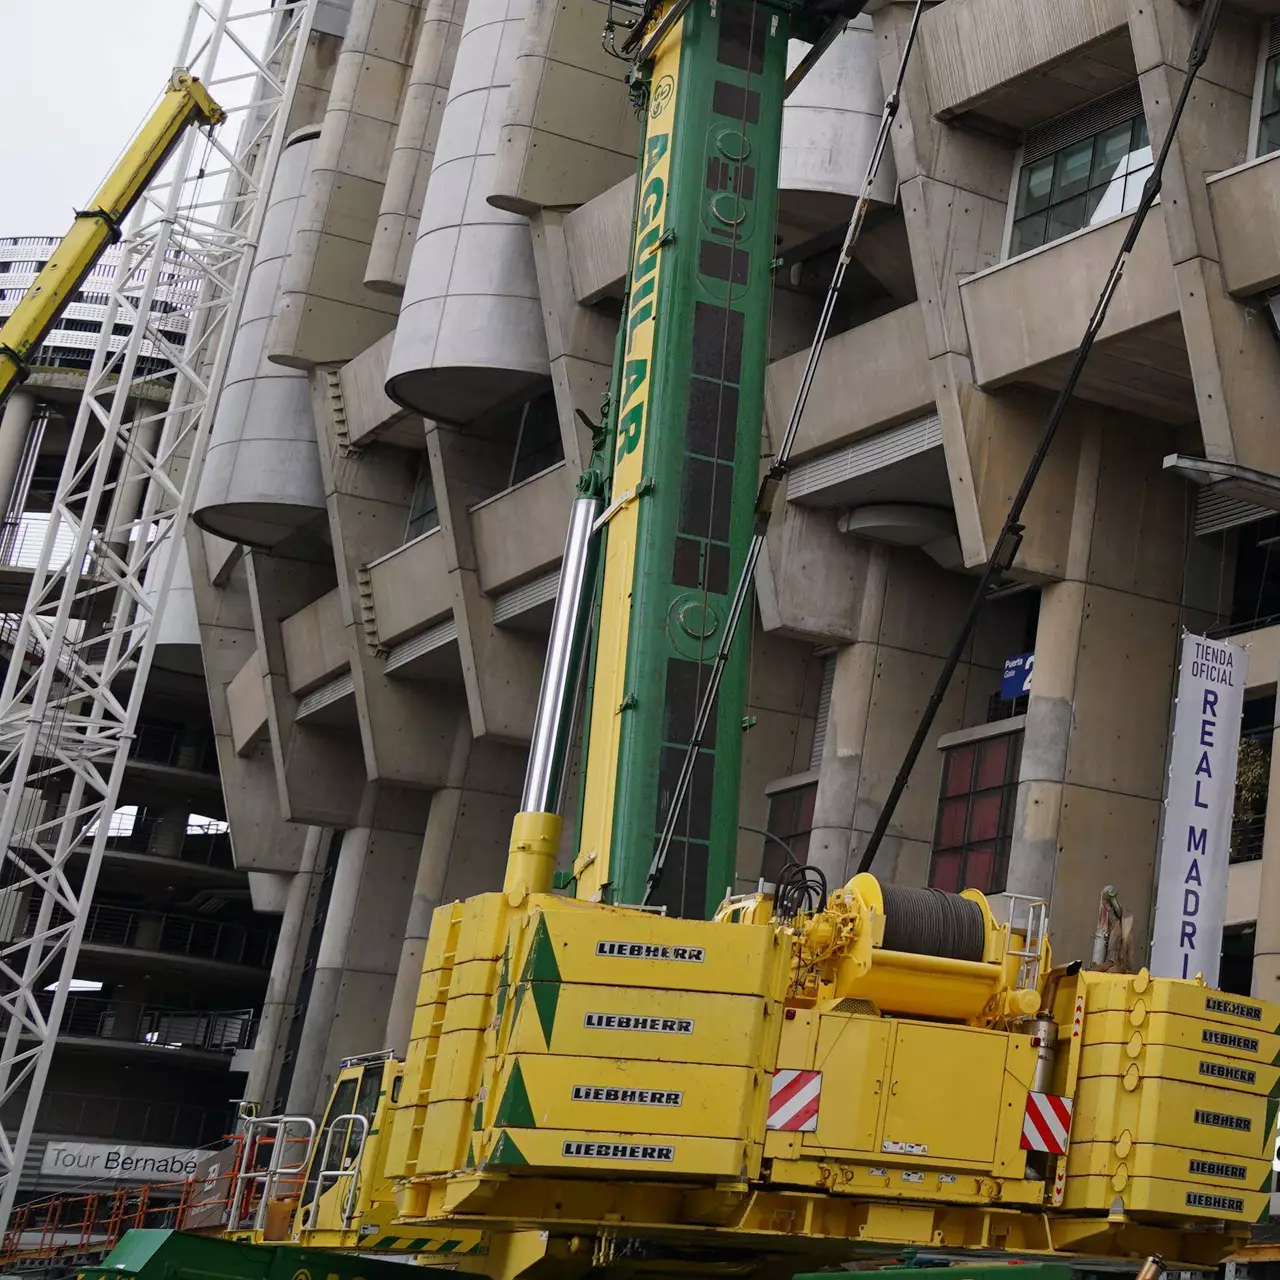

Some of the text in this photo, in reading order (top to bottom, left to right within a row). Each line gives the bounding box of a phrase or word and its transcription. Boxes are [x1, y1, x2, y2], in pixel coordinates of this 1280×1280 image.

[617, 133, 669, 467] AGUILAR
[1195, 642, 1233, 668] TIENDA
[1191, 661, 1234, 687] OFICIAL
[1194, 688, 1219, 809] REAL
[597, 943, 703, 961] LIEBHERR
[1206, 998, 1261, 1019] LIEBHERR
[585, 1015, 692, 1033] LIEBHERR
[1202, 1029, 1258, 1051] LIEBHERR
[1200, 1062, 1255, 1083] LIEBHERR
[574, 1087, 681, 1105] LIEBHERR
[1194, 1110, 1251, 1131] LIEBHERR
[52, 1148, 197, 1174] Tour Bernabé
[564, 1143, 673, 1160] LIEBHERR
[1190, 1160, 1246, 1179] LIEBHERR
[1186, 1193, 1243, 1211] LIEBHERR
